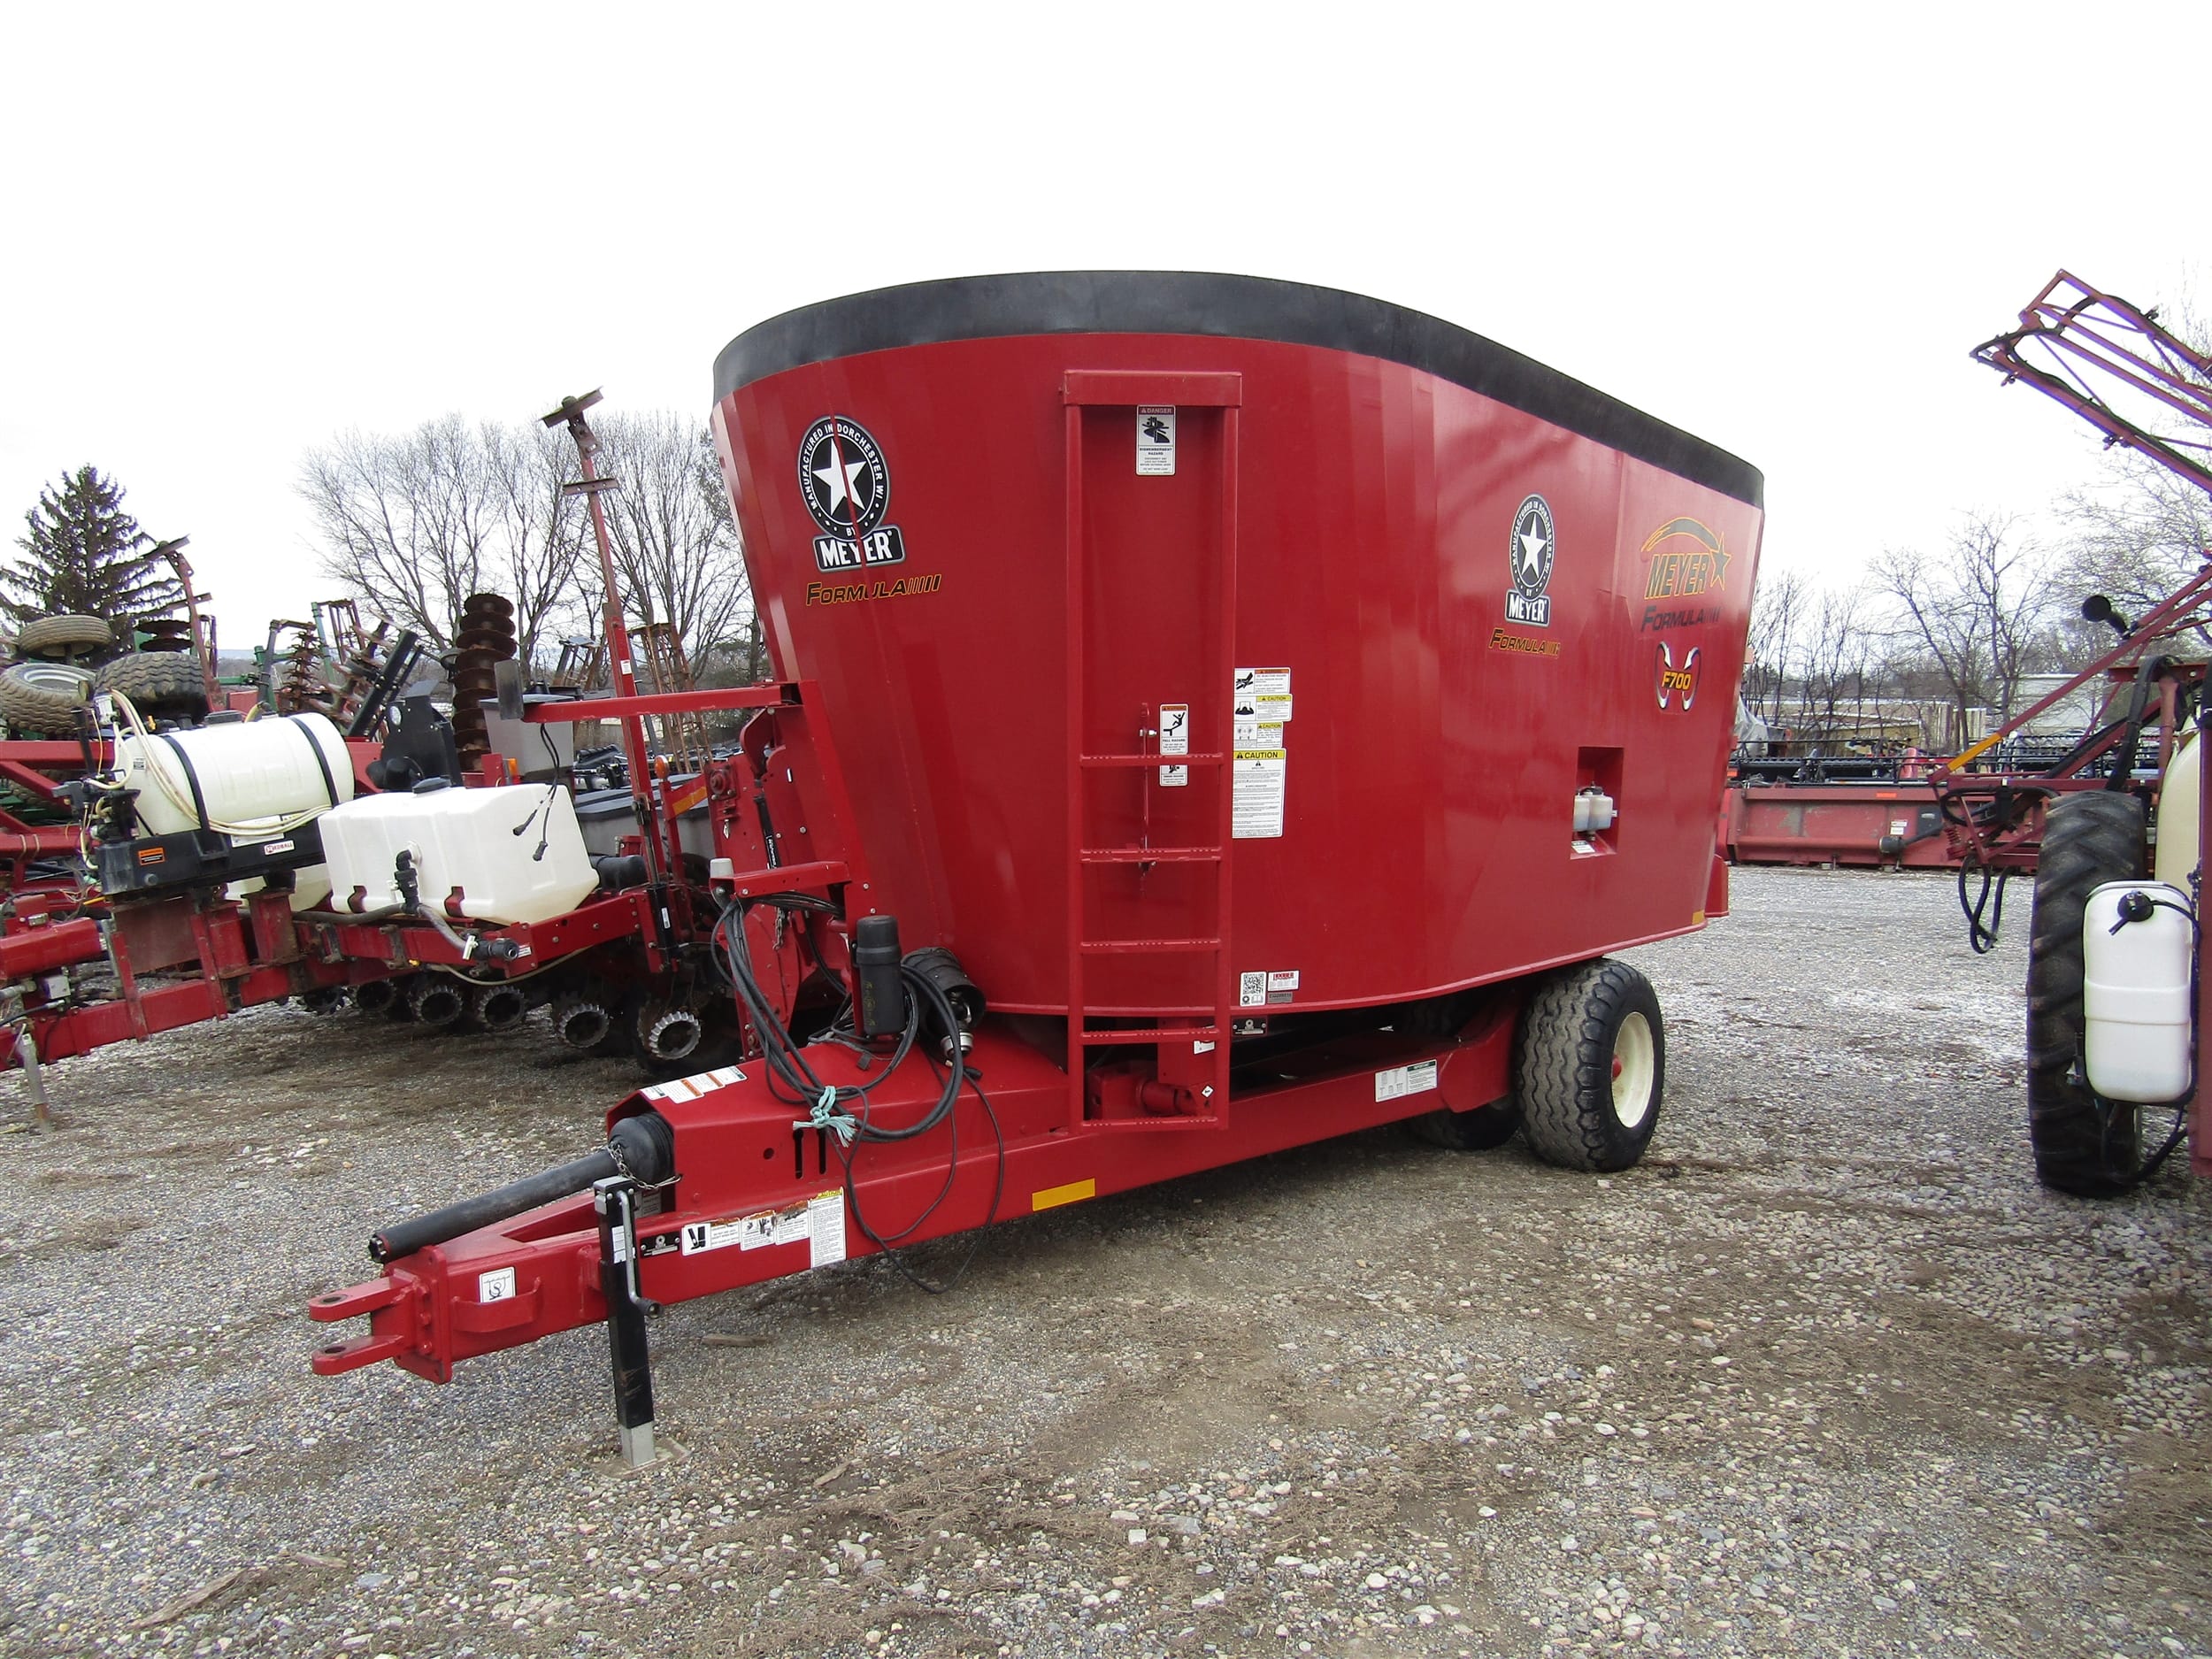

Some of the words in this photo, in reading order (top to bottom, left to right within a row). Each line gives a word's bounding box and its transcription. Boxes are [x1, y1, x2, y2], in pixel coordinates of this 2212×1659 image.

[802, 428, 824, 511] MANUFACTURED
[825, 423, 833, 434] IN
[837, 423, 883, 480] DORCHESTER
[875, 485, 884, 499] WI
[818, 531, 893, 567] MEYER
[1644, 553, 1710, 600] MEYER
[1509, 594, 1545, 622] MEYER
[1662, 671, 1692, 691] F700
